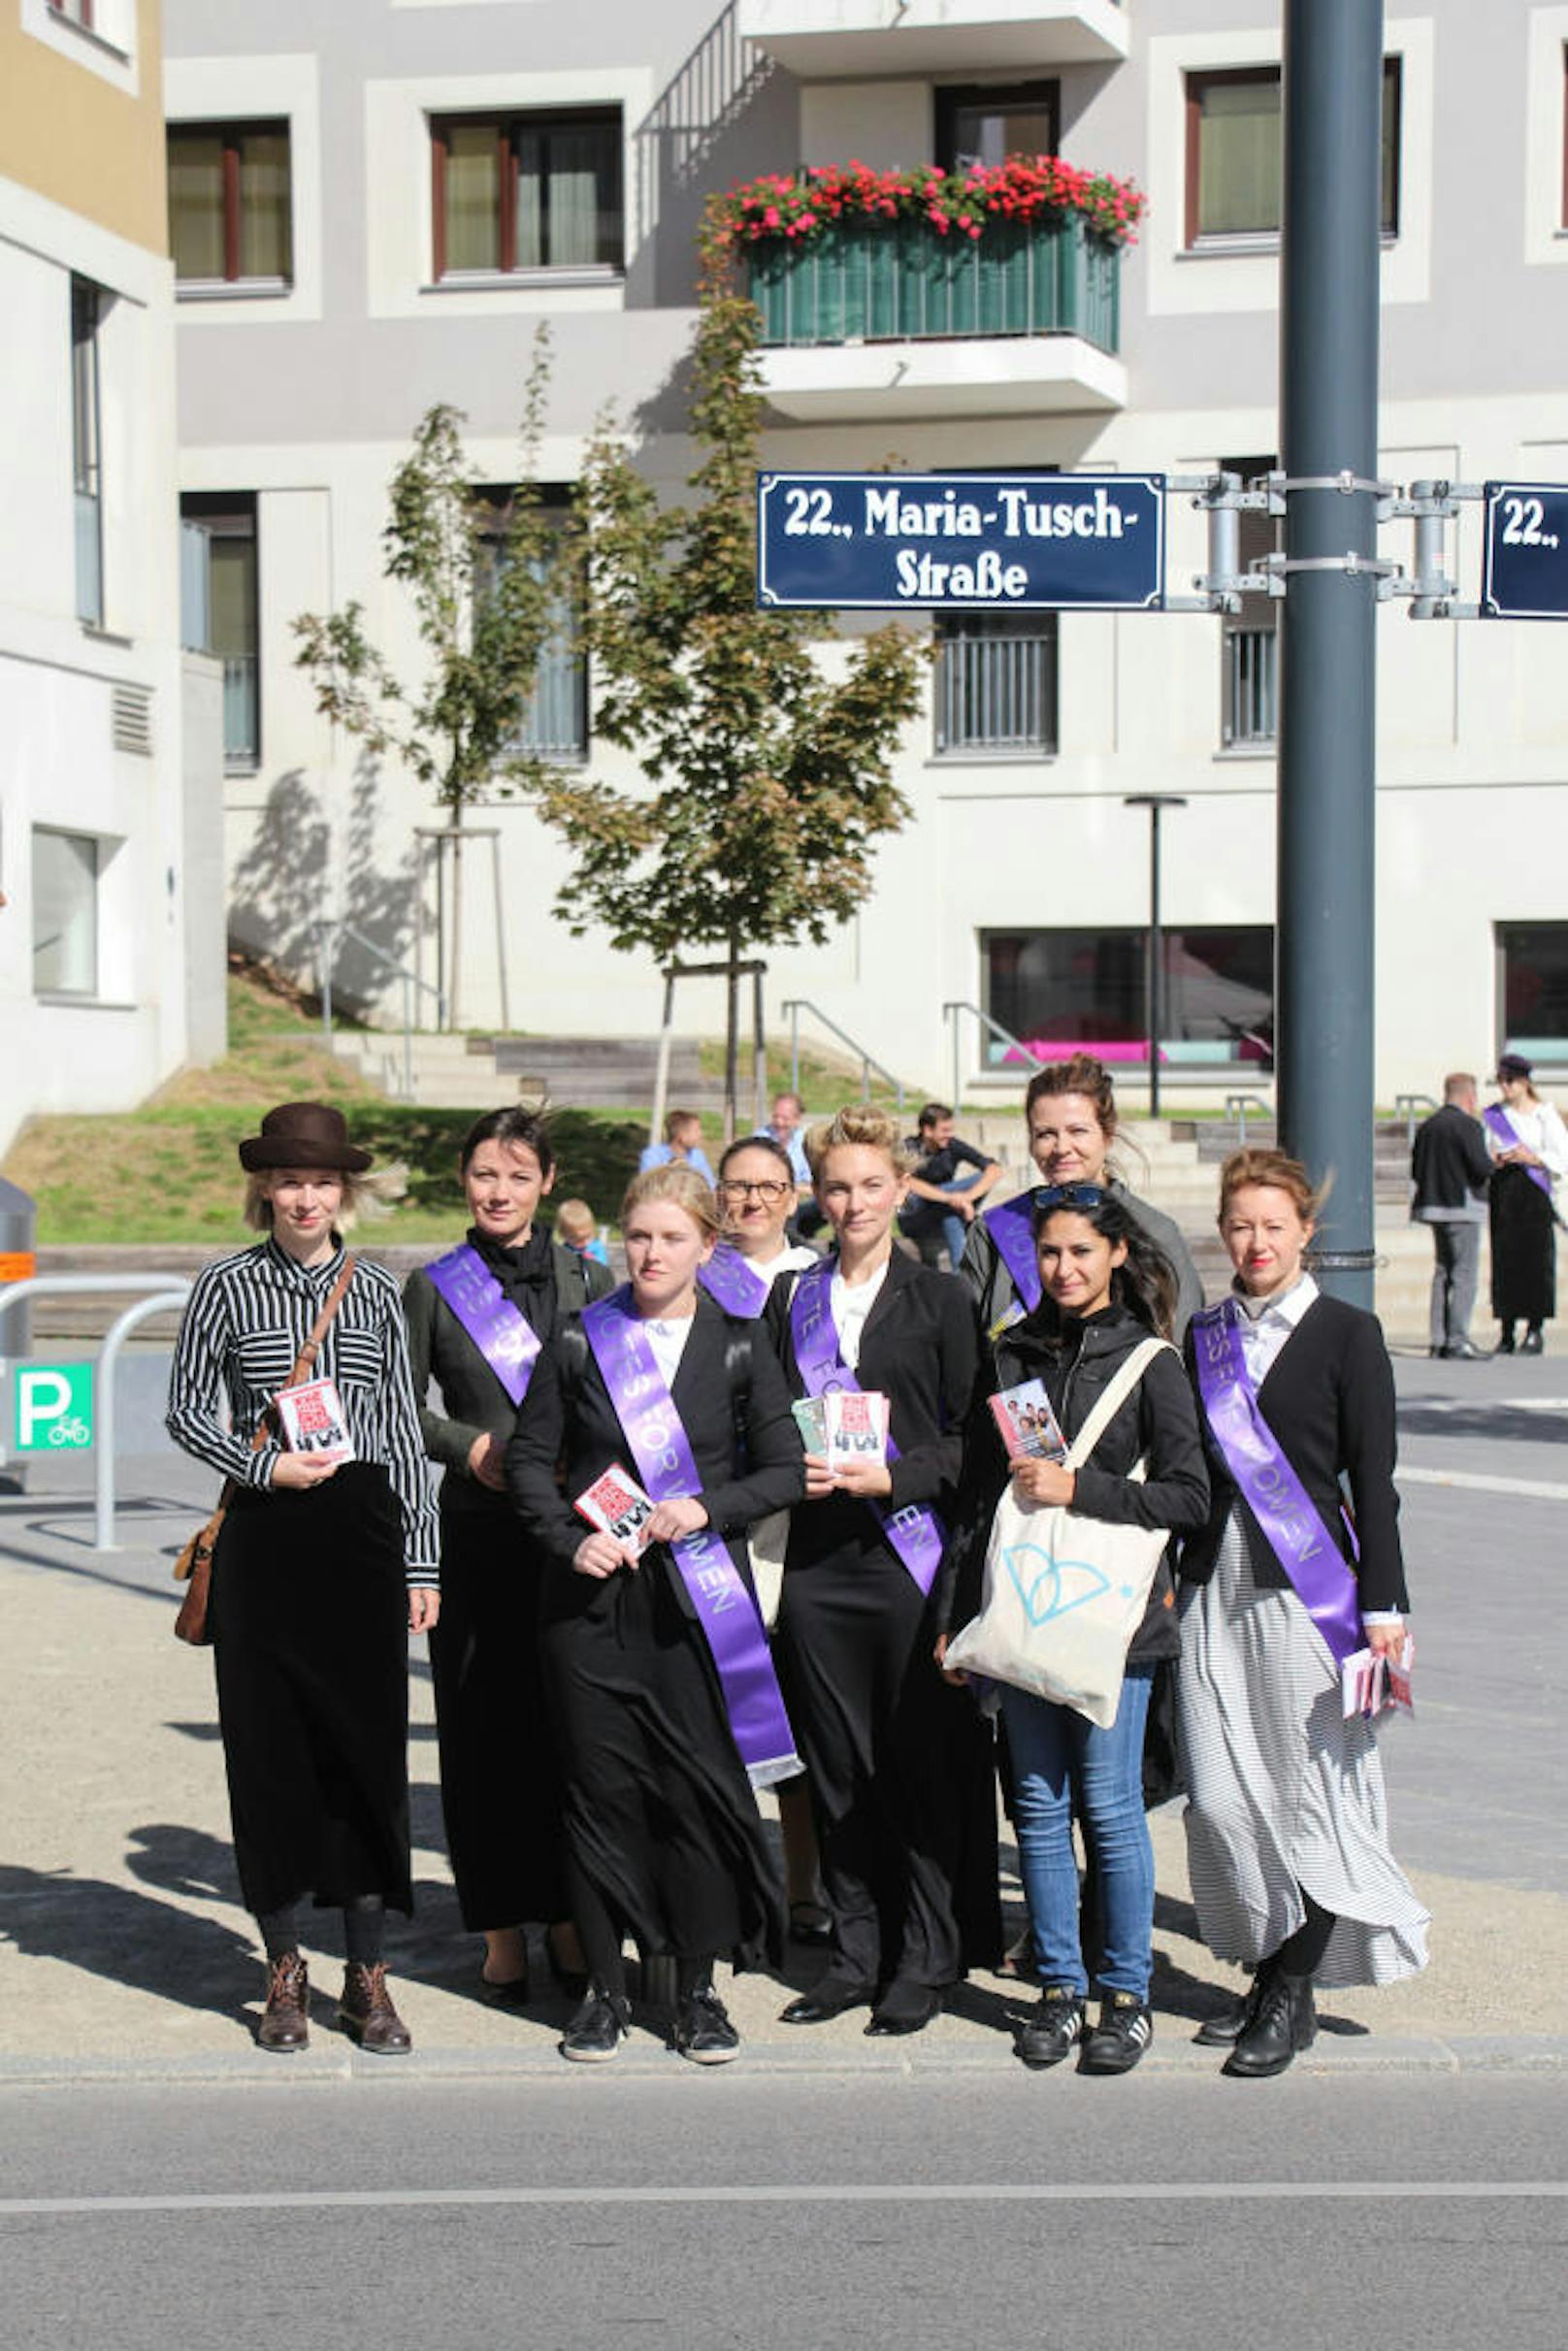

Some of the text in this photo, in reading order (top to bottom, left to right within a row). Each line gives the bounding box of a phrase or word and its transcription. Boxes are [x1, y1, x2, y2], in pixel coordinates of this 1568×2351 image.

[784, 489, 1138, 539] 22., Maria-Tusch-
[1502, 497, 1559, 549] 22.,
[896, 549, 1029, 598] Straße
[19, 1372, 73, 1446] P
[639, 1406, 679, 1478] FOR
[1253, 1462, 1323, 1564] OMEN
